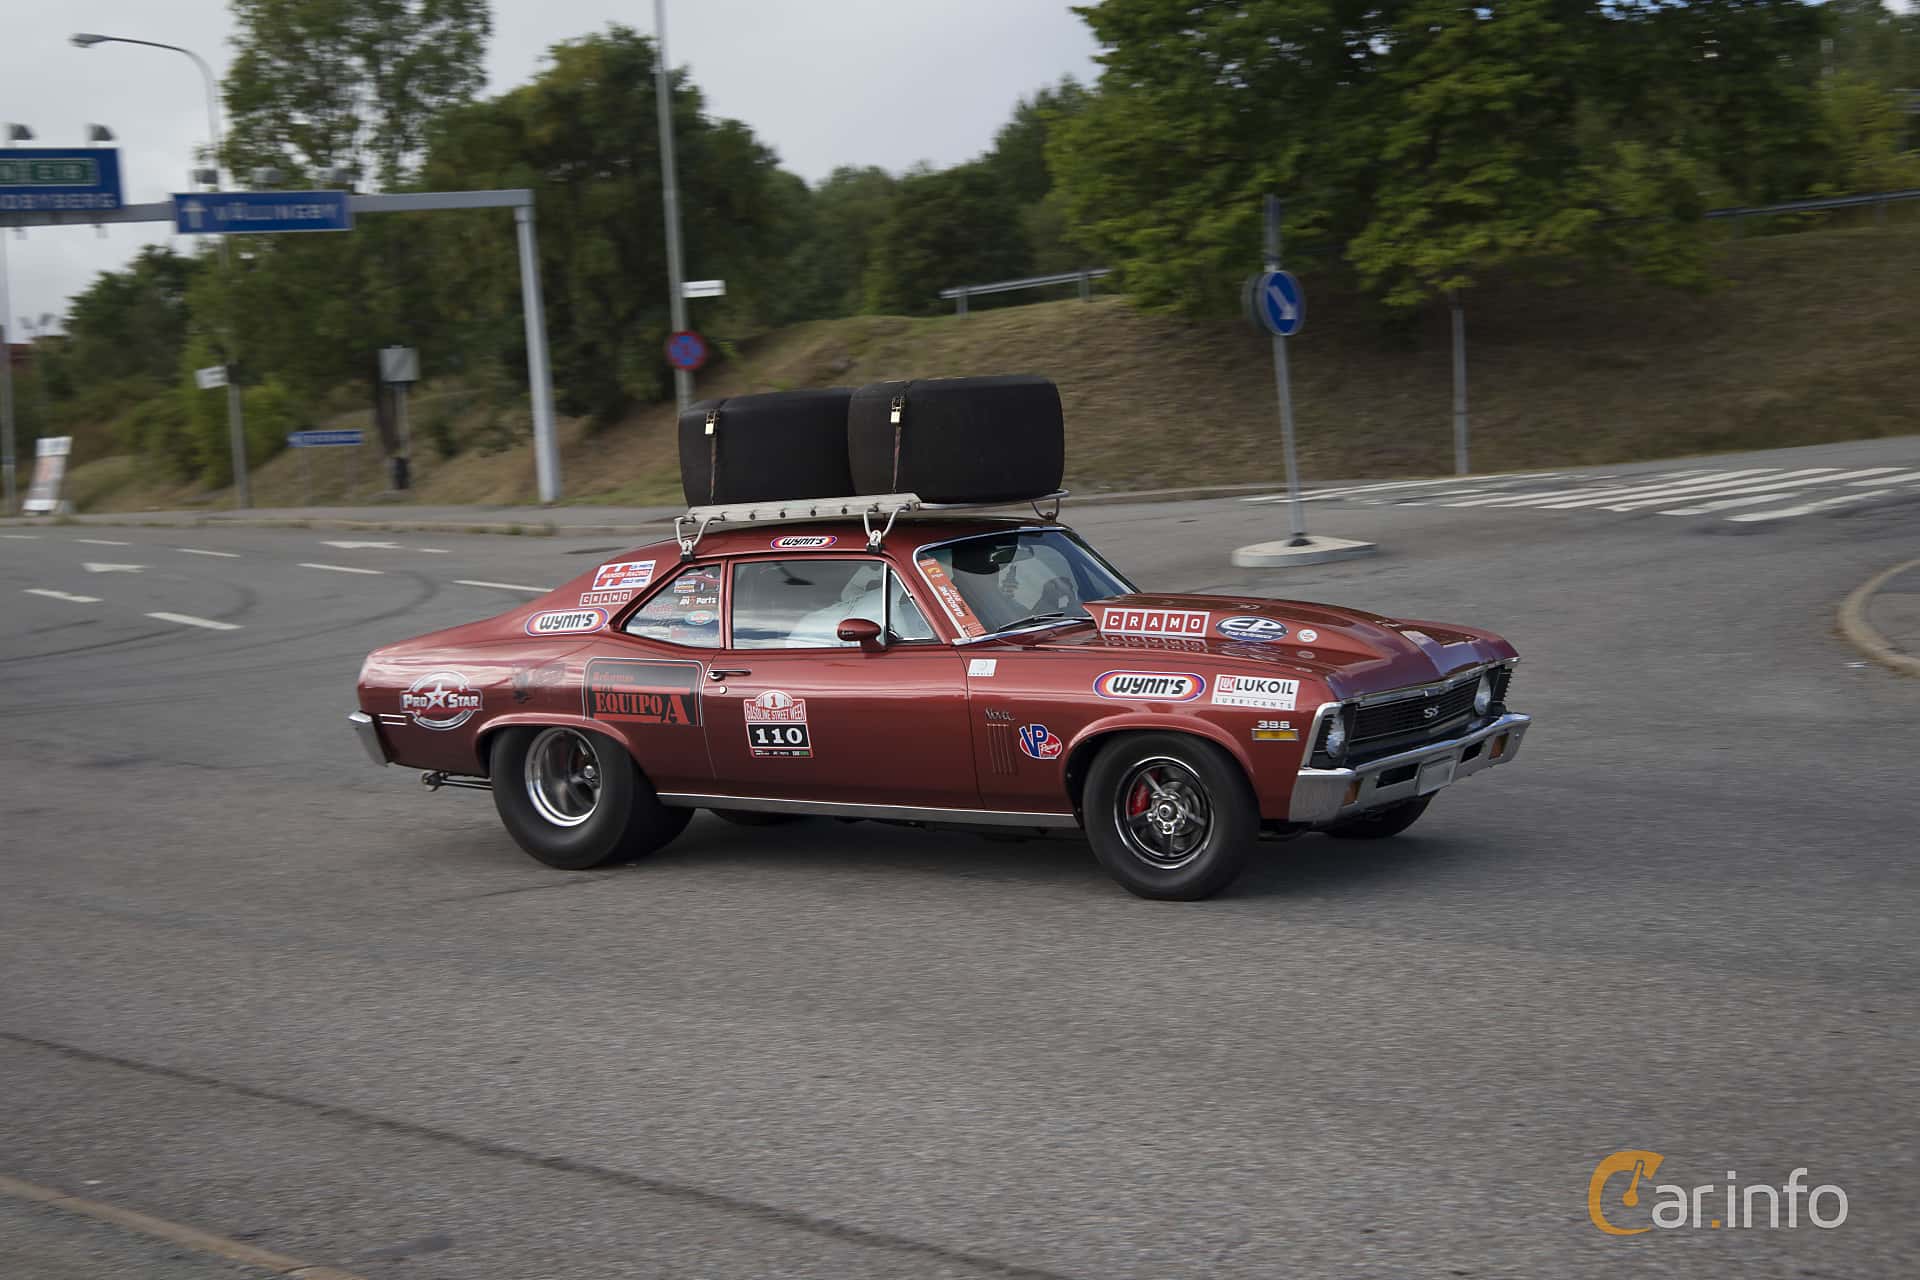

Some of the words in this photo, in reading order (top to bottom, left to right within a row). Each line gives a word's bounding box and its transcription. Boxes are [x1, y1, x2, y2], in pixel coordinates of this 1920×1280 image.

[1109, 615, 1201, 629] CRAMO
[1236, 678, 1294, 695] LUKOIL
[594, 691, 664, 715] EQUIPO
[662, 694, 691, 725] A
[1214, 697, 1293, 709] LUBRICANTS
[755, 727, 803, 745] 110
[1019, 723, 1049, 759] VP
